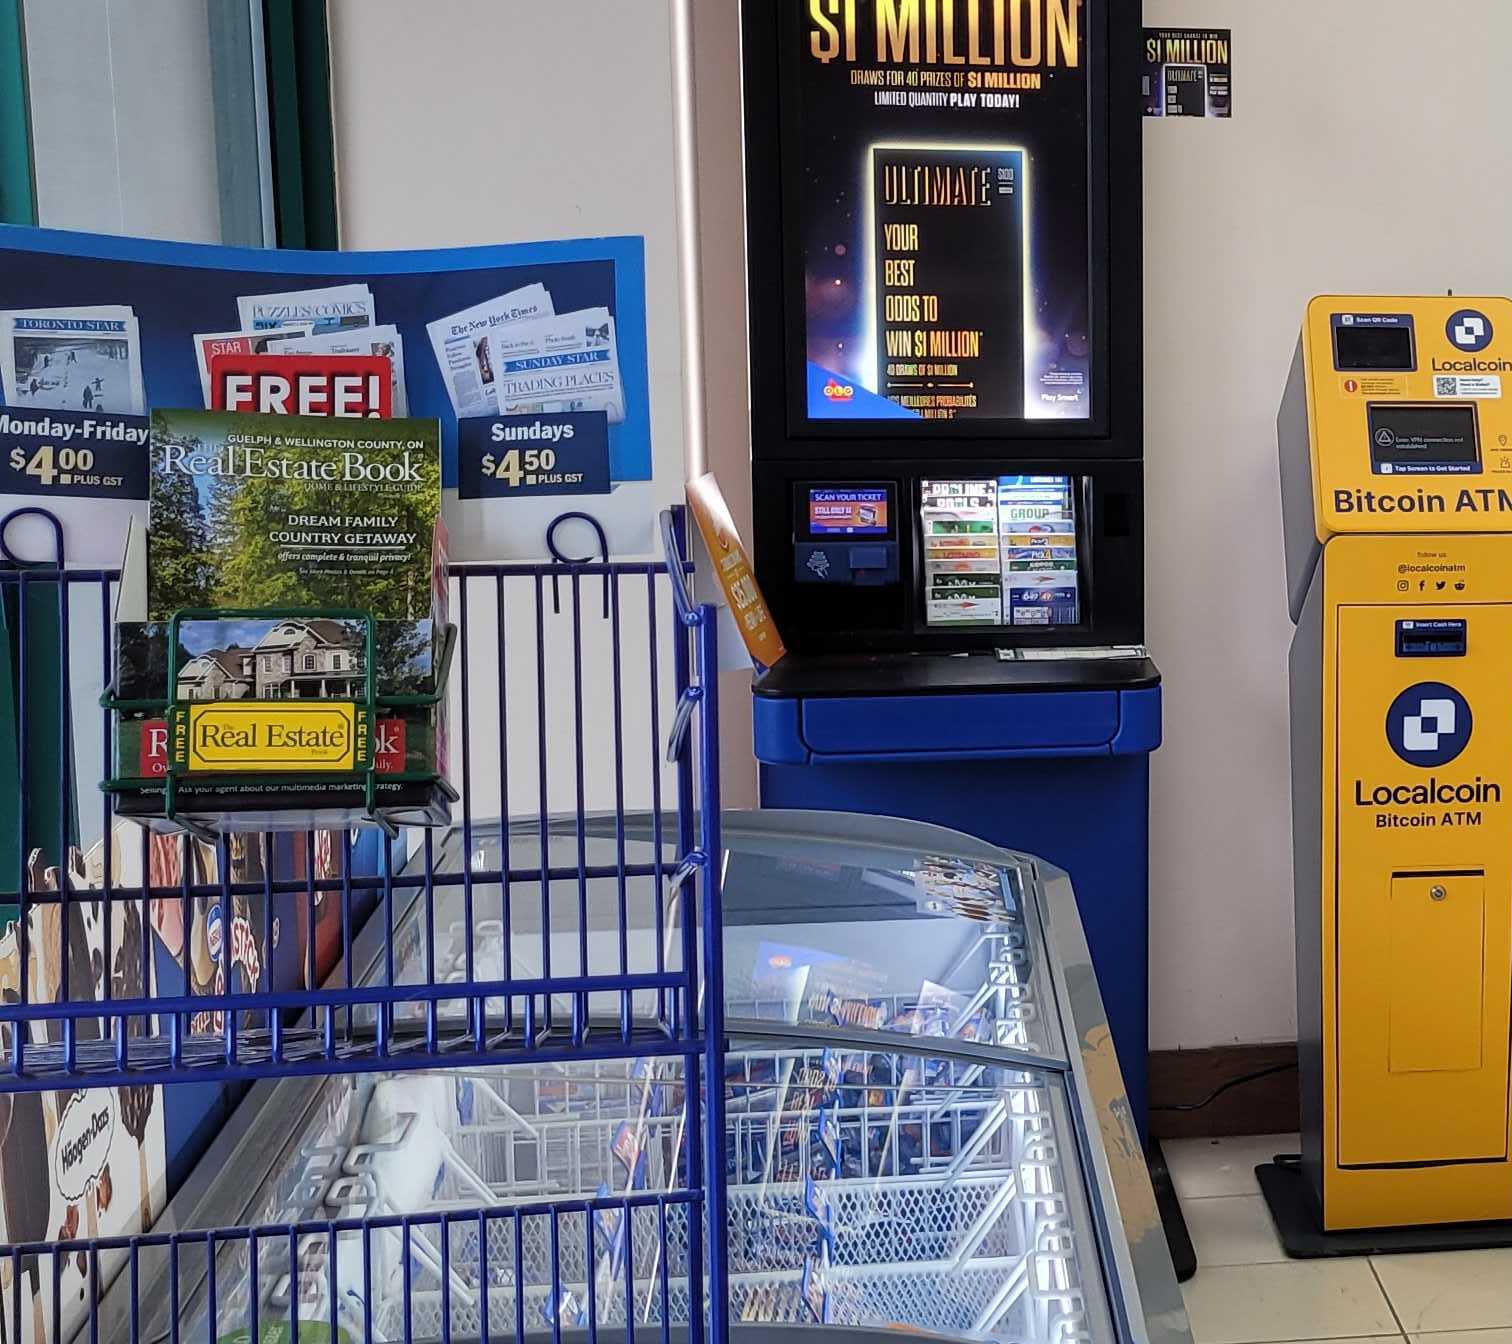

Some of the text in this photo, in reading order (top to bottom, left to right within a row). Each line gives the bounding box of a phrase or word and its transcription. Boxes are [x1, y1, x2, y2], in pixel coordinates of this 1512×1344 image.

[1166, 39, 1228, 64] MILLION
[850, 70, 1041, 89] DRAWS FOR 40 PRIZES OF $1 MILLION
[874, 91, 1020, 109] LIMITED QUANTITY PLAY TODAY!
[884, 165, 992, 207] ULTIMATE
[884, 223, 919, 252] YOUR
[885, 259, 916, 287] BEST
[886, 295, 938, 322] ODDS TO
[21, 319, 120, 331] TORONTO STAR
[451, 305, 538, 336] The New York Times
[211, 341, 242, 355] STAR
[886, 330, 912, 358] WIN
[914, 330, 928, 359] $1
[516, 351, 600, 371] SUNDAY STAR
[1431, 357, 1512, 372] Localcoin
[505, 371, 615, 394] TRADING PLACES
[226, 376, 380, 417] FREE!
[1057, 392, 1079, 403] Smart
[491, 421, 575, 442] Sundays
[228, 434, 424, 450] GUELPH & WELLINGTON COUNTY, ON
[162, 445, 425, 482] Real Estate Book
[74, 475, 123, 486] PLUS GST
[344, 483, 423, 492] LIFESTYLE GUIDE
[538, 473, 583, 484] PLUS GST
[815, 493, 882, 502] SCAN YOUR TICKET
[1333, 488, 1445, 513] Bitcoin
[288, 515, 399, 528] DREAM FAMILY
[1011, 508, 1050, 519] GROUP
[269, 531, 417, 545] COUNTRY GETAWAY
[277, 552, 301, 562] offers
[301, 552, 338, 562] complete
[346, 552, 379, 563] tranquil
[1398, 563, 1466, 574] @localcoinatm
[175, 712, 186, 763] FREE
[200, 723, 345, 748] Real Estate
[357, 711, 367, 761] FREE
[195, 786, 213, 795] your
[215, 786, 238, 794] agent
[239, 784, 263, 793] about
[281, 784, 327, 792] multimedia
[1355, 776, 1501, 806] Localcoin
[1375, 812, 1482, 828] Bitcoin ATM
